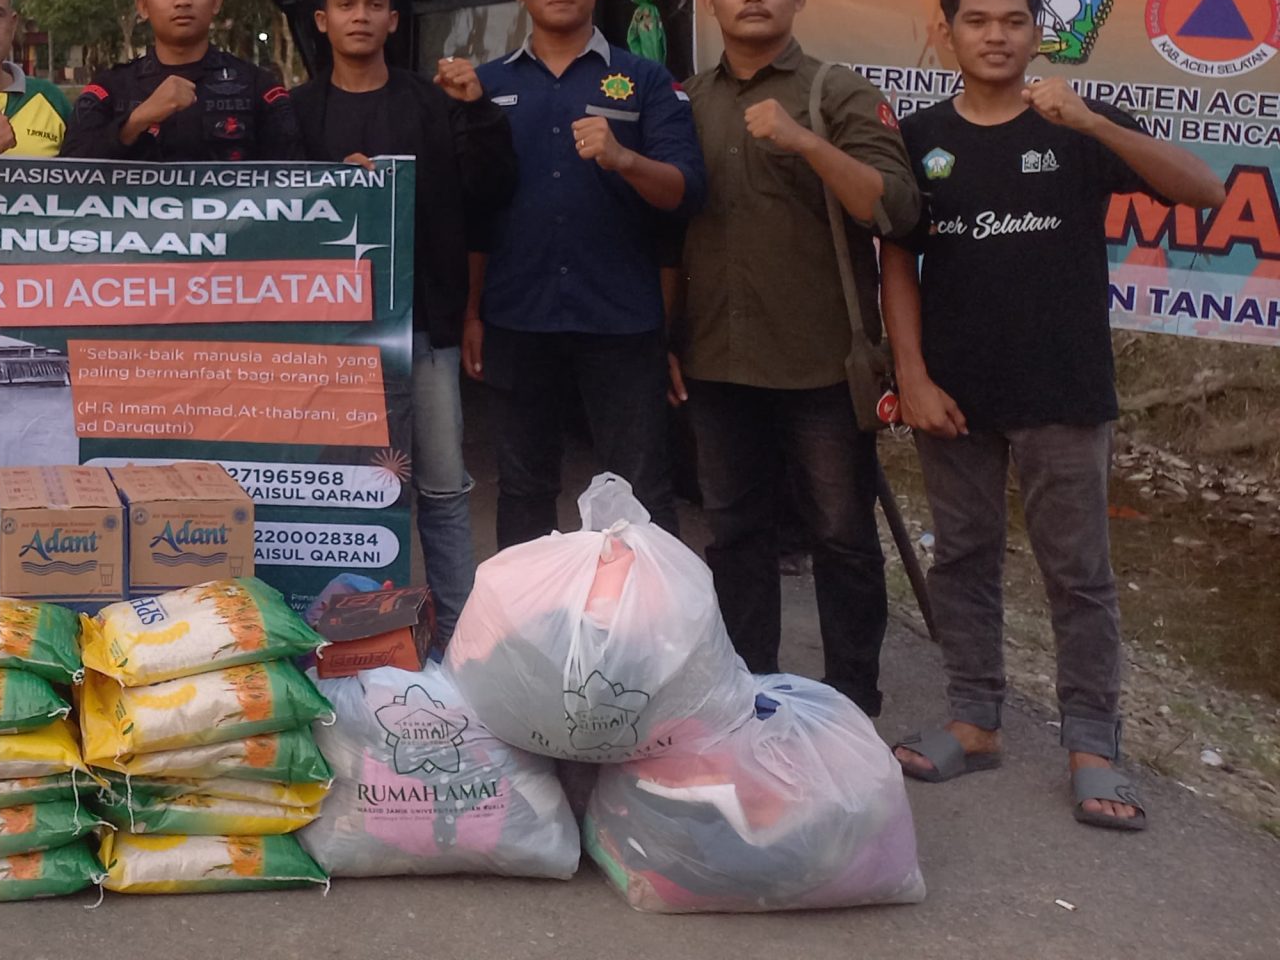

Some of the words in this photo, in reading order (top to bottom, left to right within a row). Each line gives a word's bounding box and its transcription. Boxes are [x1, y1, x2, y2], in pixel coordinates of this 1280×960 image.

[1180, 58, 1214, 74] ACEH
[1217, 49, 1268, 75] SELATAN
[1208, 91, 1280, 117] ACE
[1182, 121, 1280, 146] BENCA
[111, 170, 196, 187] PEDULI
[200, 170, 269, 188] ACEH
[274, 169, 385, 189] SELATAN
[191, 198, 343, 223] DANA
[937, 215, 968, 235] ceh
[972, 210, 1062, 240] Selatan
[16, 278, 54, 309] DI
[63, 277, 176, 308] ACEH
[185, 274, 363, 305] SELATAN
[193, 349, 263, 363] manusia
[271, 352, 328, 365] adalah
[337, 356, 379, 368] yang
[78, 366, 130, 380] paling
[135, 366, 231, 380] bermanfaat
[237, 368, 275, 384] bagi
[280, 373, 330, 385] orang
[120, 402, 167, 415] Imam
[345, 408, 378, 422] dan
[76, 419, 98, 432] ad
[227, 467, 345, 486] 271965968
[311, 489, 385, 503] QARANI
[18, 528, 98, 561] Adant
[149, 520, 229, 553] Adant
[254, 548, 305, 561] AISUL
[310, 550, 381, 563] QARANI
[129, 598, 165, 625] SPH
[357, 784, 437, 806] RUMAH
[445, 780, 504, 802] AMAL
